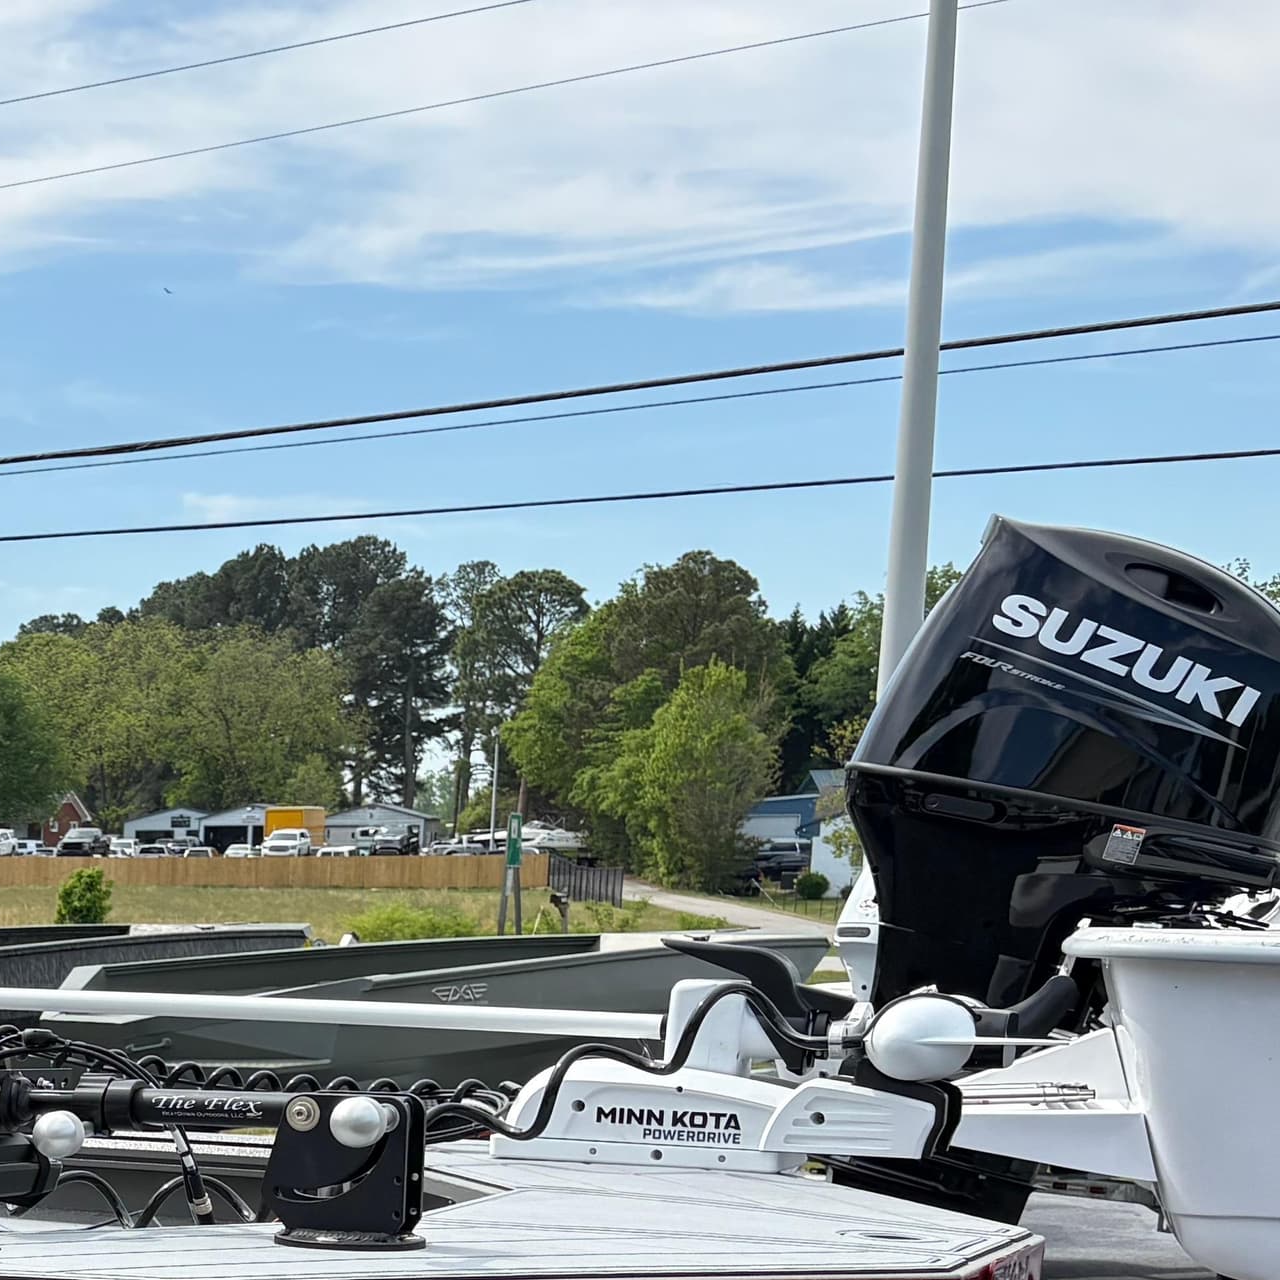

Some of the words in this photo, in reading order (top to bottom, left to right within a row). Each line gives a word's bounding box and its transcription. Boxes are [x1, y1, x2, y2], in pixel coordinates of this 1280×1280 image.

[992, 594, 1262, 728] SUZUKI
[151, 1095, 196, 1109] The
[204, 1096, 263, 1116] Flex
[596, 1106, 665, 1127] MINN
[671, 1110, 741, 1131] KOTA
[643, 1128, 741, 1145] POWERDRIVE
